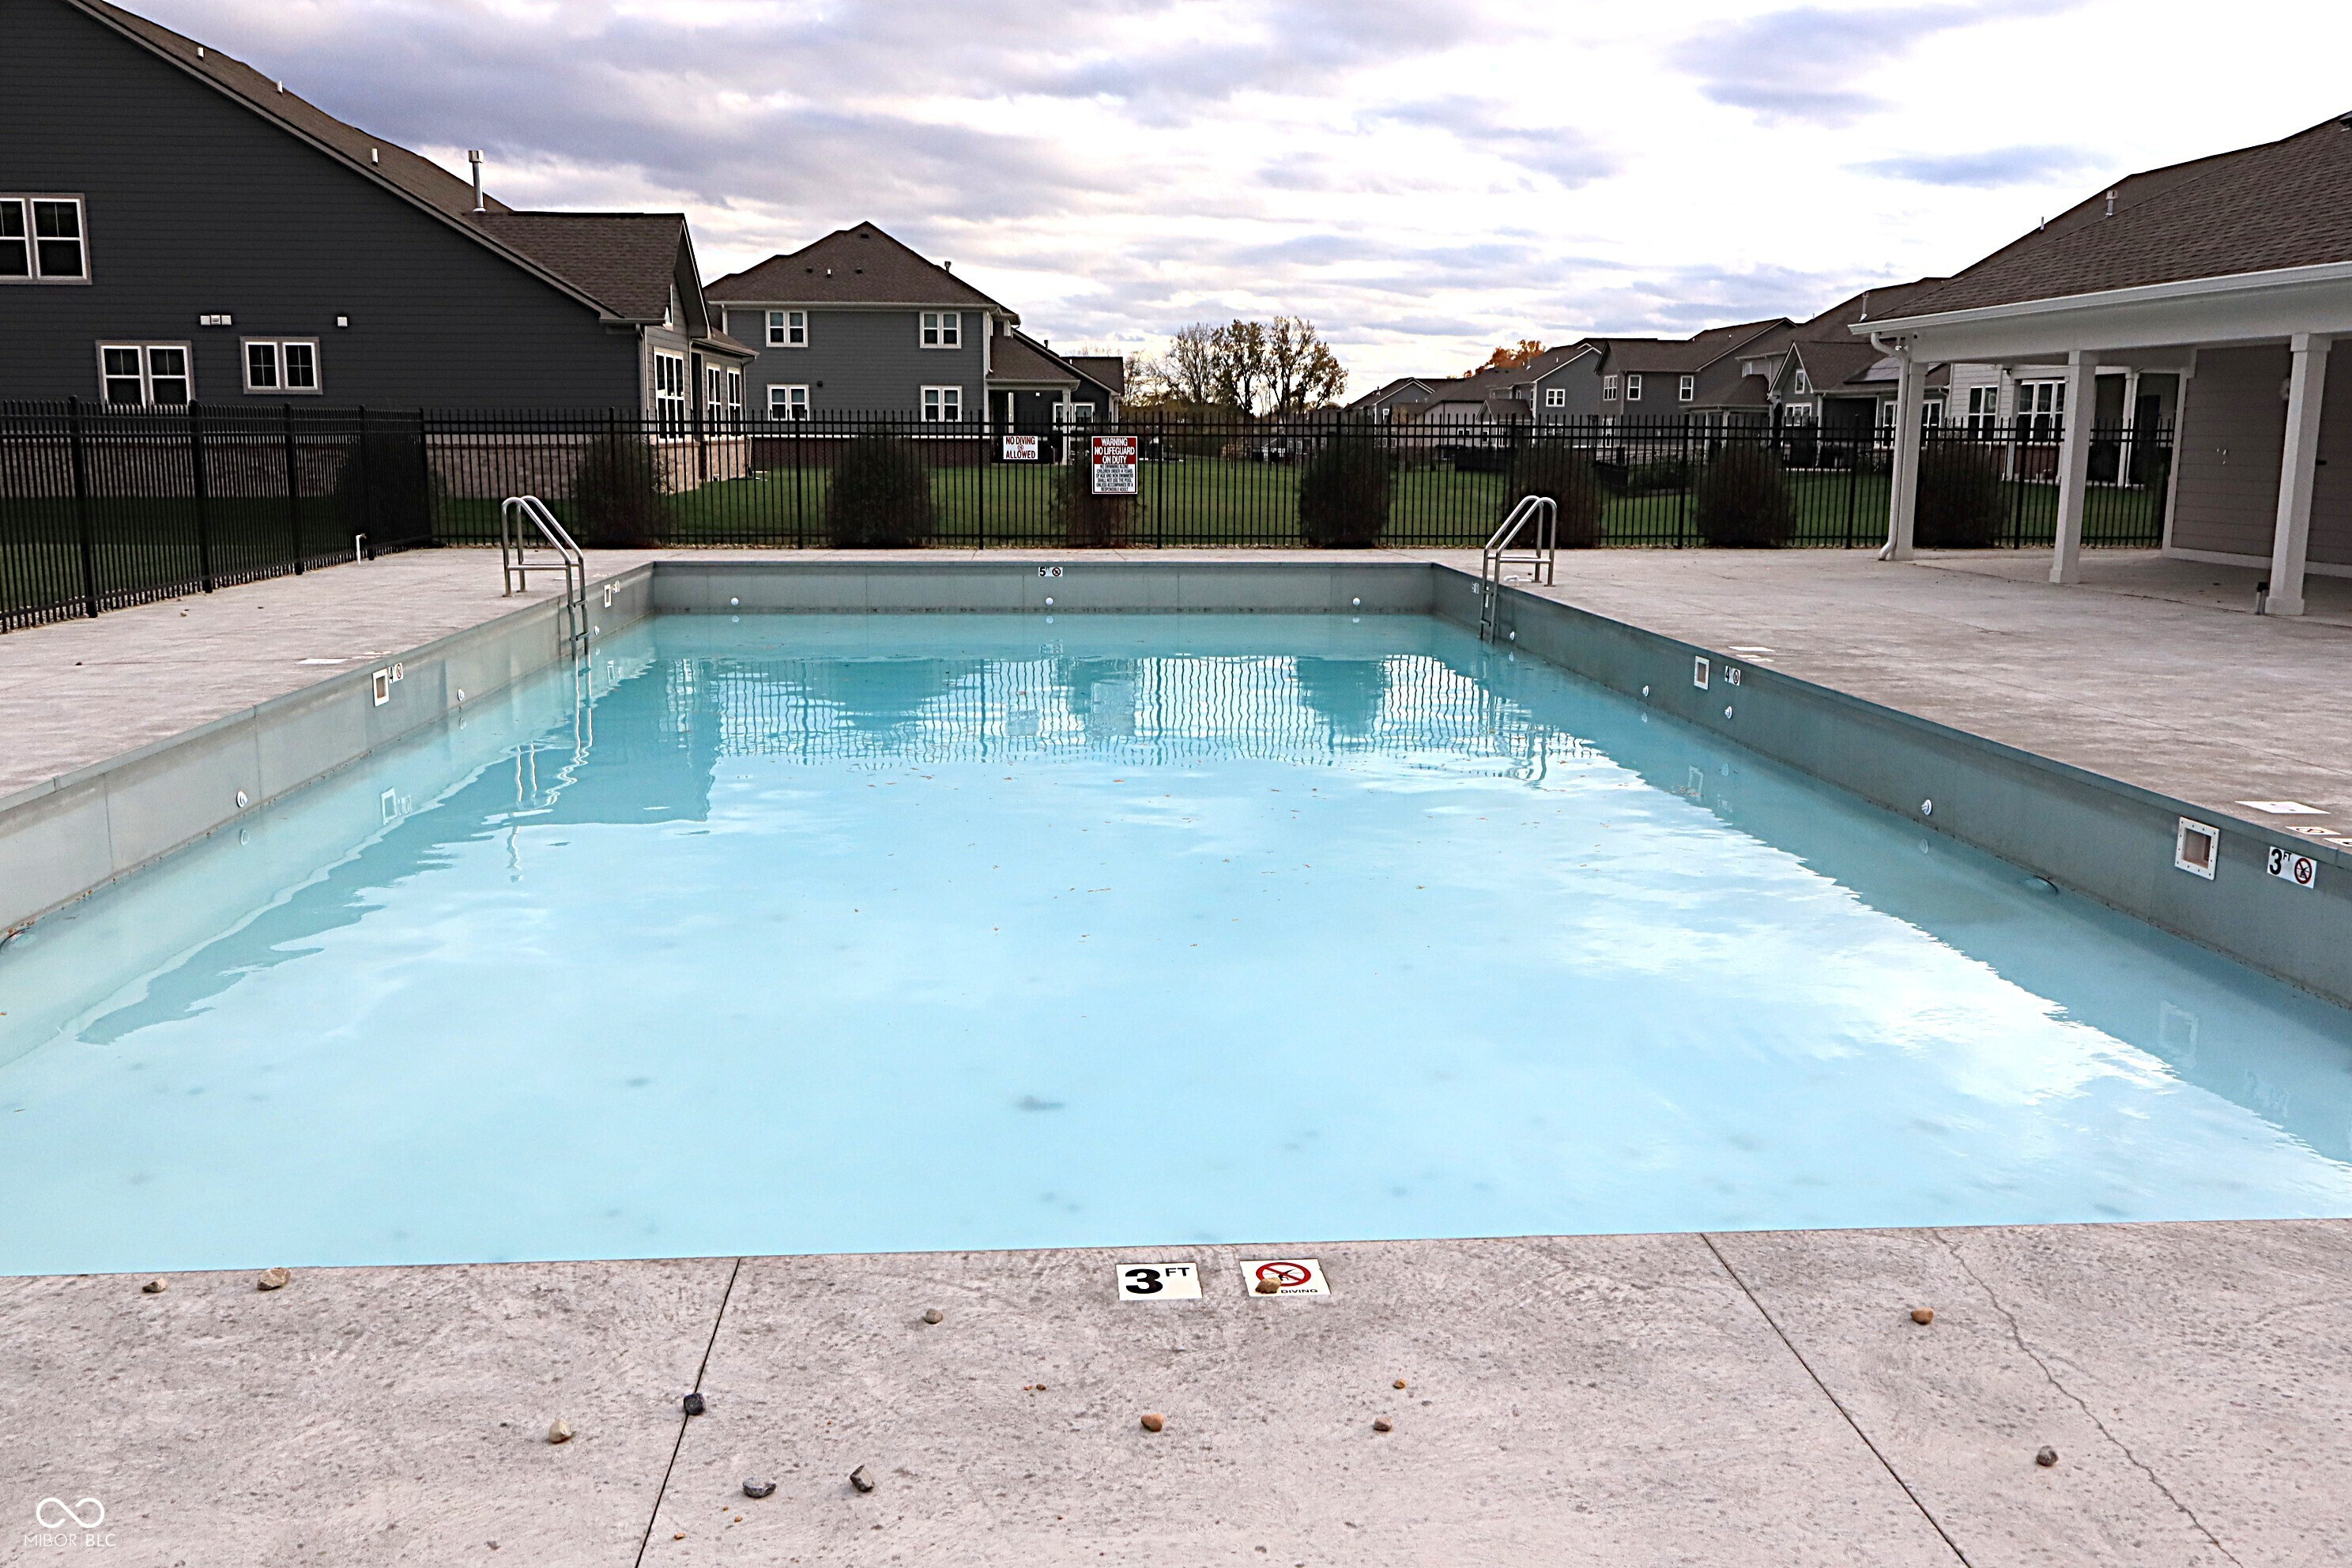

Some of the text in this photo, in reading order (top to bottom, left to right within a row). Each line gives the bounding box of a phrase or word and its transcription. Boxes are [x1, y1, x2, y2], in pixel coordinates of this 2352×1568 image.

[1005, 436, 1035, 445] NO DIVING
[1101, 438, 1128, 447] WARNING
[1006, 450, 1035, 459] ALLOWED
[1095, 447, 1135, 455] NO LIFEGUARD
[1102, 455, 1127, 464] ON DUTY
[2270, 849, 2292, 875] 3 FT
[1125, 1267, 1190, 1295] 3 FT
